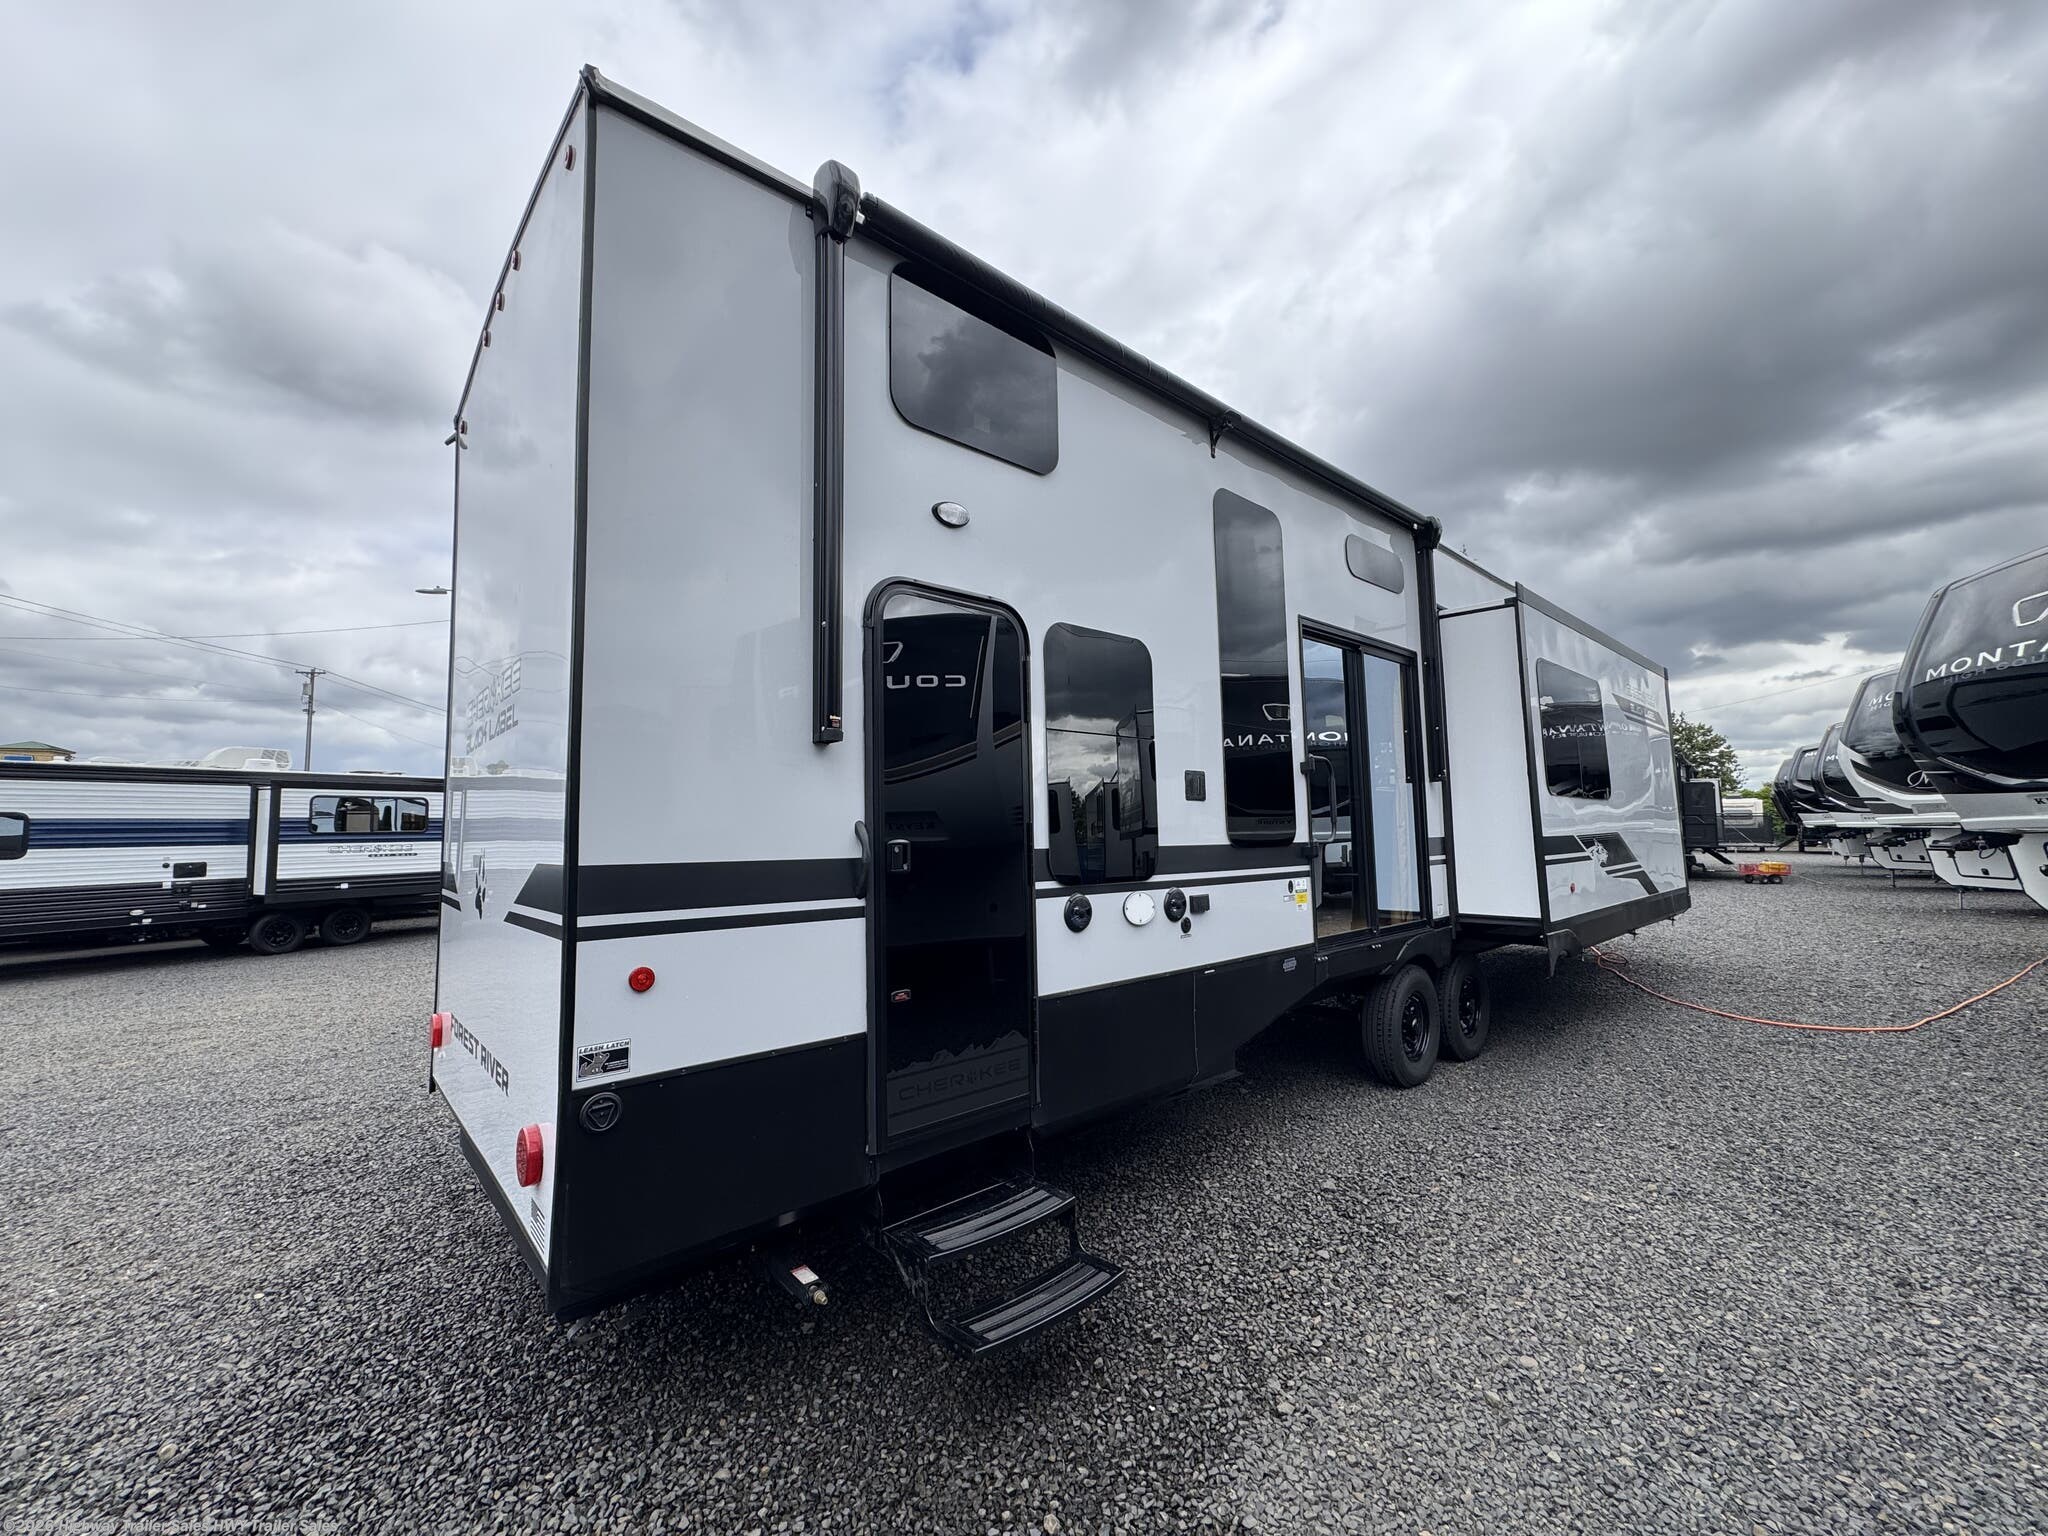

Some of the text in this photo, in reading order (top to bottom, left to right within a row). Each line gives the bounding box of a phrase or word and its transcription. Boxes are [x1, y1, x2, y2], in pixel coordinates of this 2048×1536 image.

[1943, 666, 1987, 686] HIGH
[488, 703, 519, 741] LABEL
[450, 1012, 510, 1098] FOREST RIVER
[579, 1041, 630, 1055] LEASH LATCH
